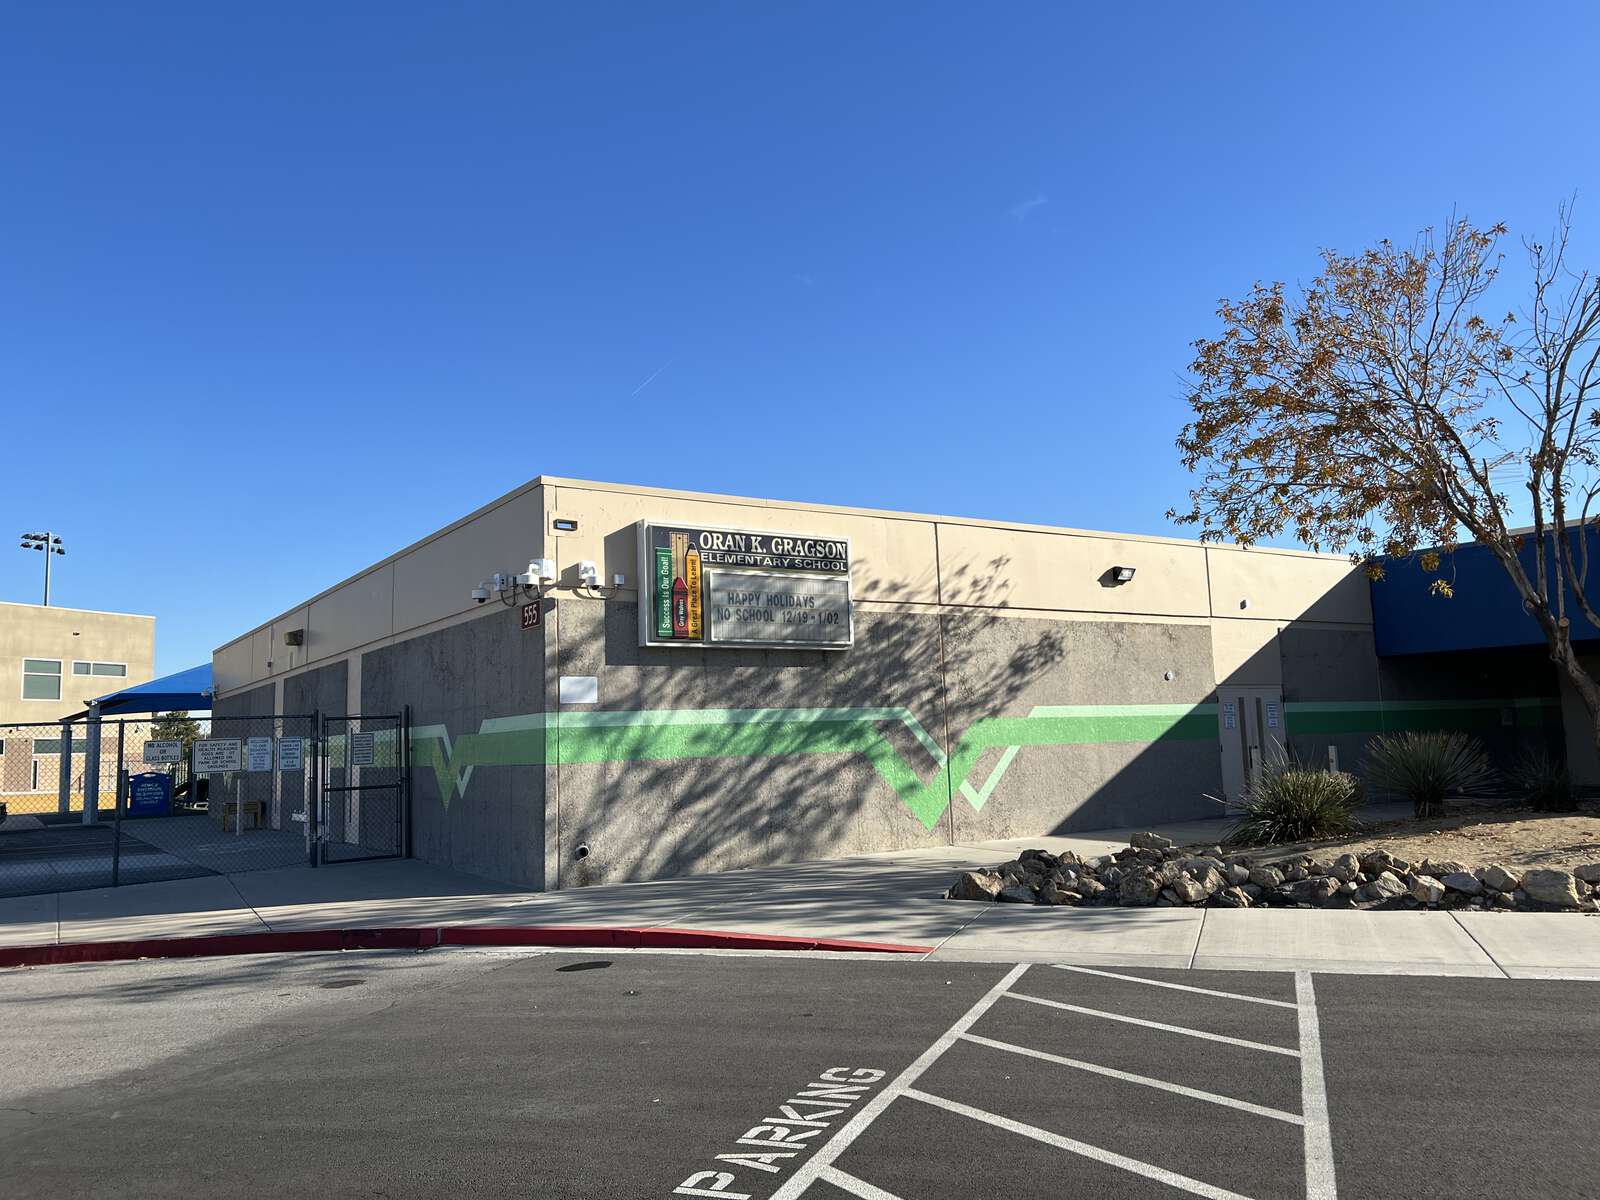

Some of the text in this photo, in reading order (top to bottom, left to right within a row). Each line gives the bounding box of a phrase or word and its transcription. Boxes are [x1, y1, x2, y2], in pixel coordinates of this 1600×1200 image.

[700, 532, 847, 559] ORAN K. GRAGSON
[661, 556, 670, 575] Goal!
[701, 552, 847, 571] ELEMENTARY SCHOOL
[661, 576, 670, 590] Our
[727, 592, 815, 609] HAPPY HOLIDAYS
[524, 603, 538, 625] 555
[662, 599, 670, 629] Success
[717, 607, 731, 621] NO
[735, 608, 775, 622] SCHOOL
[781, 611, 808, 624] 12/19
[818, 612, 840, 625] 1/02
[672, 1067, 886, 1200] PARKING
